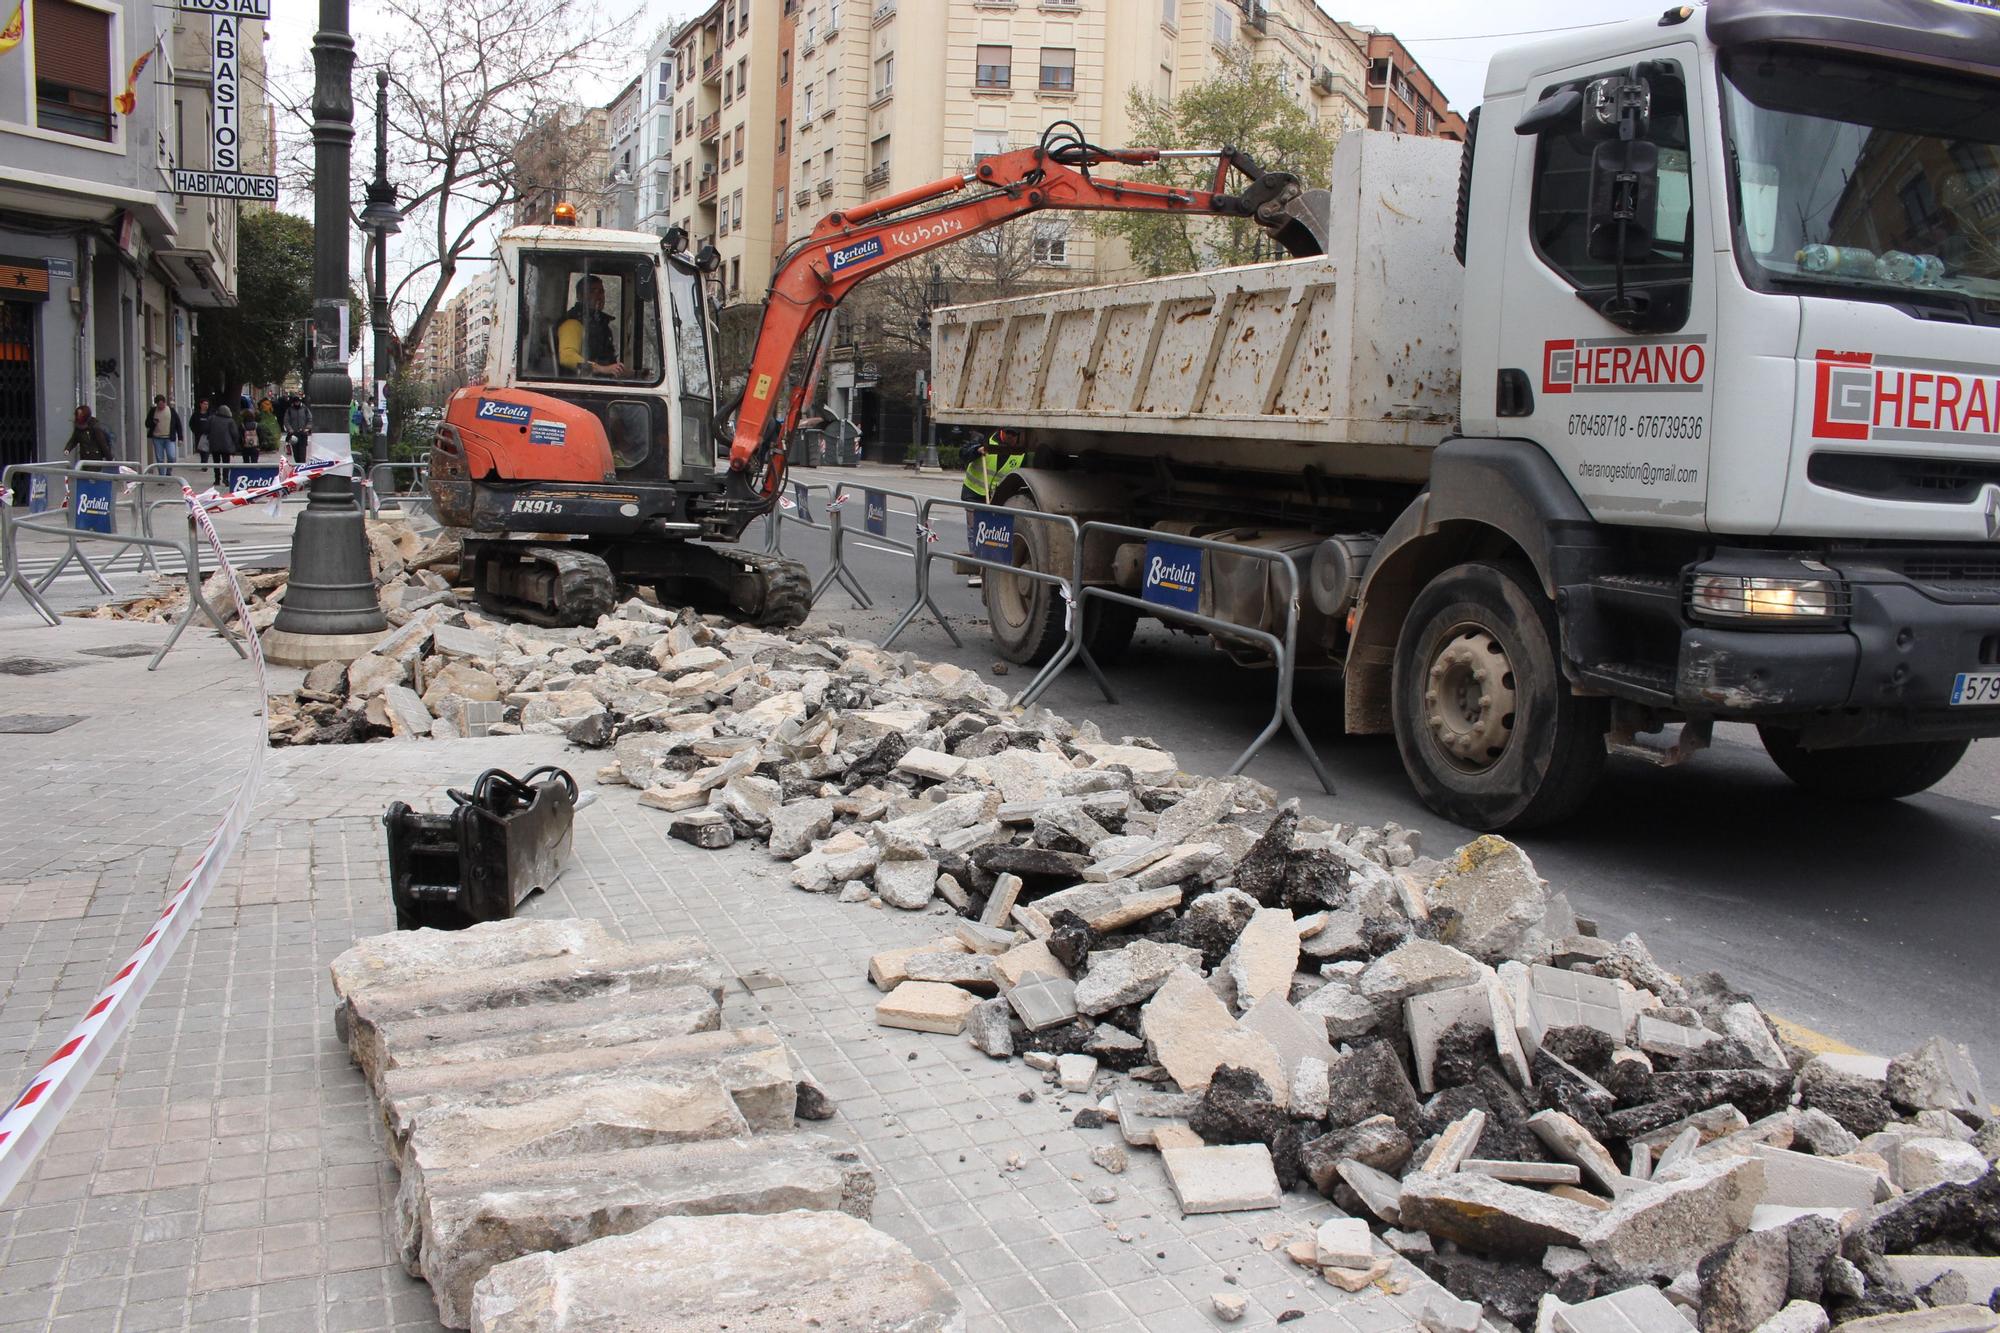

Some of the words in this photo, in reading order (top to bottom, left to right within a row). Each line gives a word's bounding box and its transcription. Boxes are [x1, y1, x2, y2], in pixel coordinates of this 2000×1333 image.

[216, 19, 236, 168] ABASTOS
[177, 172, 275, 198] HABITACIONES
[1568, 414, 1627, 437] 676458718
[1637, 416, 1703, 440] 676739536
[233, 475, 272, 493] Bertol
[1579, 460, 1698, 485] cheranogestion@gmail.com
[511, 500, 563, 514] KX91-3
